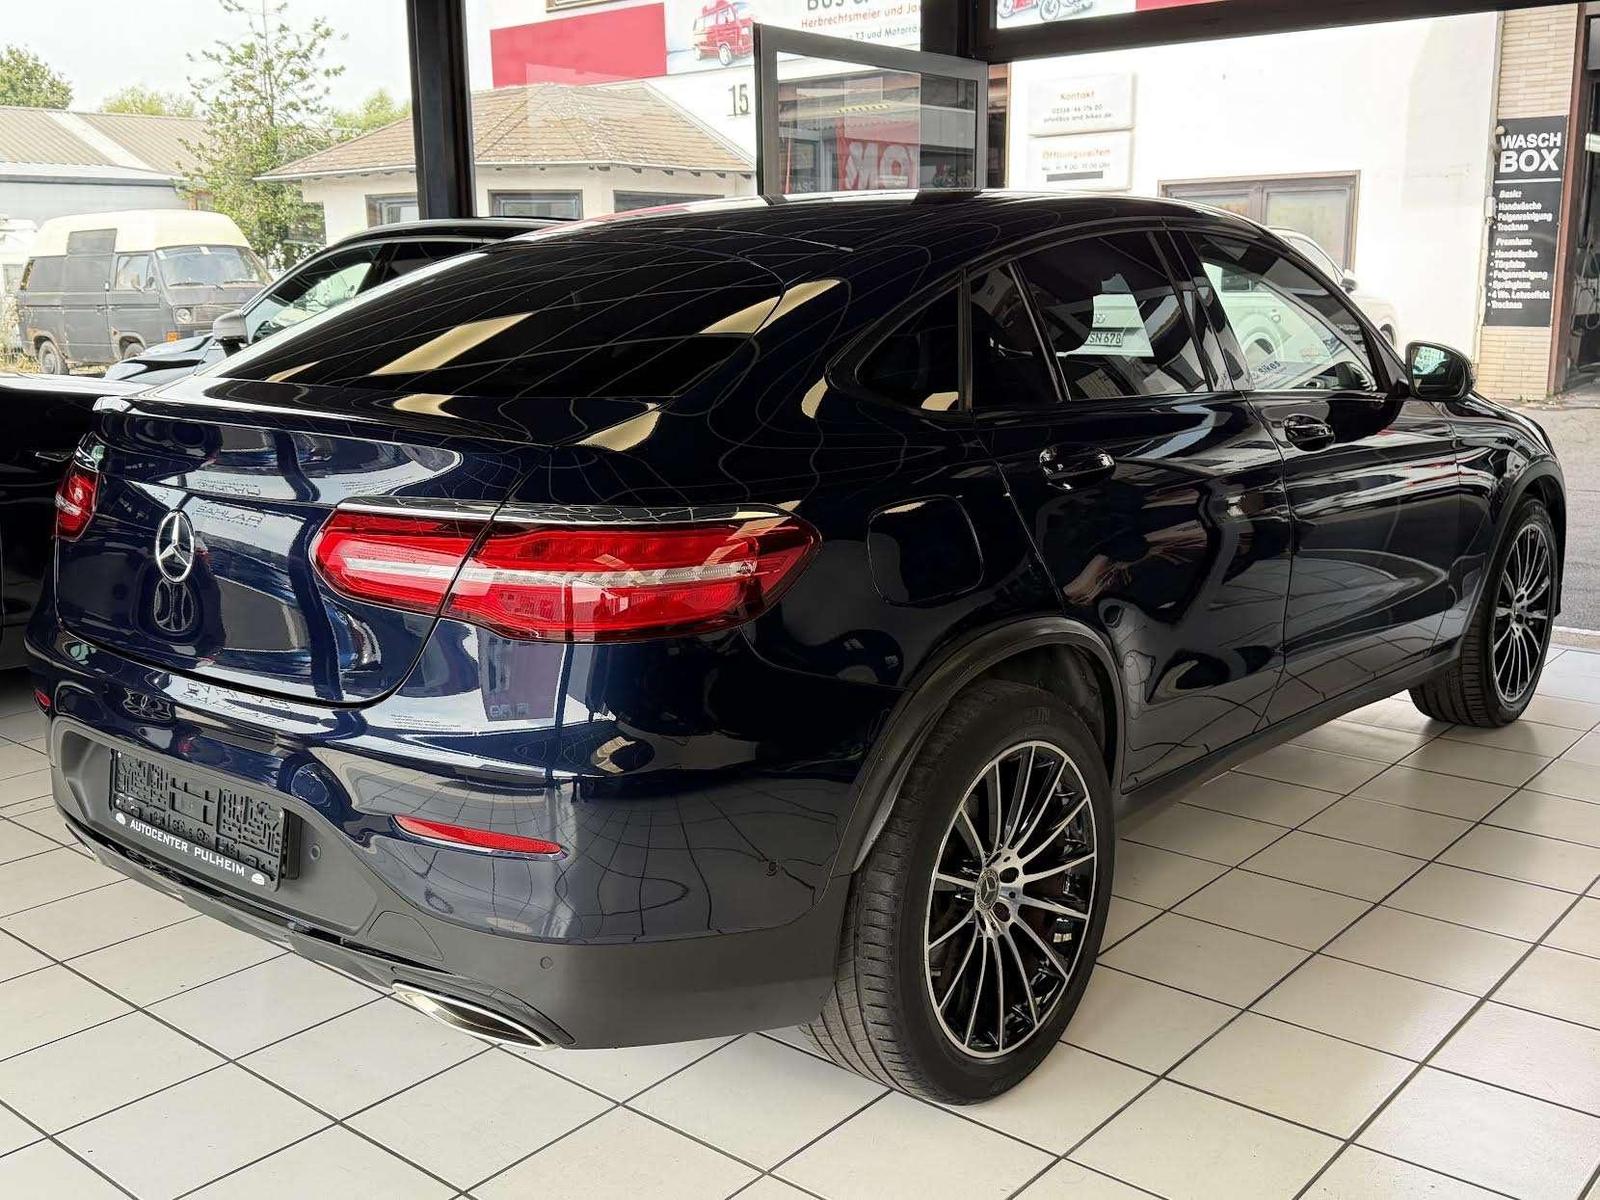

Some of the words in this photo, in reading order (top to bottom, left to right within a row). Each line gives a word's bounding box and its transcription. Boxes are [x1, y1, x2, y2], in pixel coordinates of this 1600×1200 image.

[801, 8, 881, 28] Herbrechtsmeier
[884, 6, 903, 17] und
[885, 25, 921, 37] Motorra
[728, 84, 750, 116] 15
[1501, 132, 1562, 150] WASCH
[1500, 148, 1560, 173] BOX
[130, 819, 188, 853] AUTOCENTER
[194, 846, 245, 877] PULHEIM
